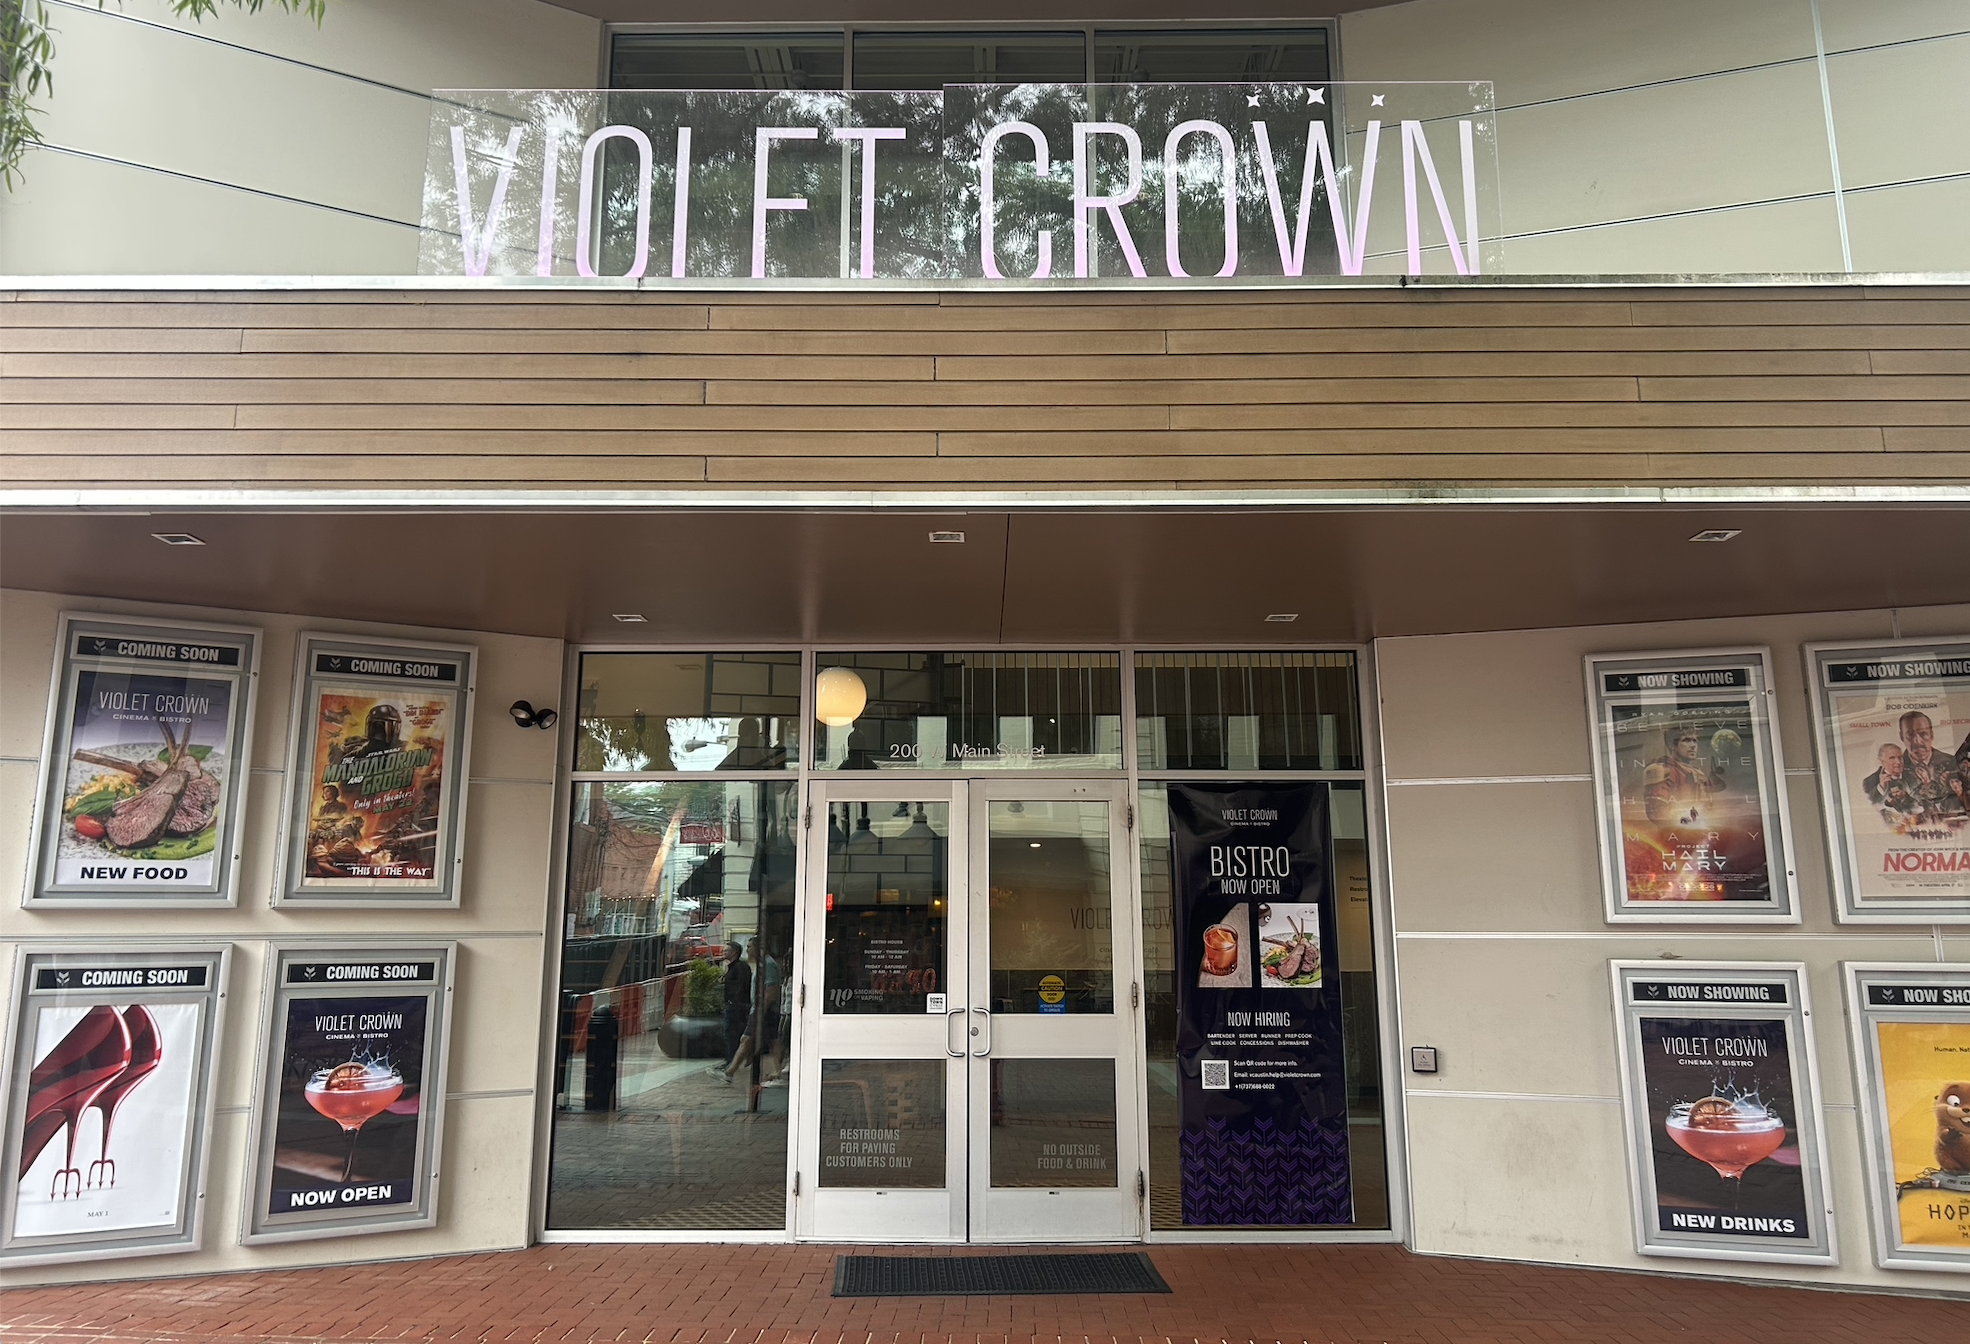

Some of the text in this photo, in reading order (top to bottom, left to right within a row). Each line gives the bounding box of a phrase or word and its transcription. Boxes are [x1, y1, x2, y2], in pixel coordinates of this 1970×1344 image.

[450, 120, 1479, 278] VIOLET CROWN
[118, 642, 219, 661] COMING SOON
[351, 659, 438, 677] COMING SOON
[1867, 661, 1970, 678] NOW SHOWING
[1638, 672, 1734, 688] NOW SHOWING
[100, 692, 209, 714] VIOLET CROWN
[1617, 720, 1747, 732] BELIEVE
[889, 743, 1045, 758] 200 W Main Street
[322, 748, 433, 783] MANDALORIAN
[342, 757, 355, 765] THE
[1621, 757, 1751, 768] IN THE
[361, 767, 415, 796] GROGU
[373, 799, 413, 814] MAY 22
[1222, 808, 1278, 820] VIOLET CROWN
[1627, 831, 1758, 841] MARY
[1211, 846, 1289, 877] BISTRO
[1662, 850, 1726, 859] HAIL
[1884, 852, 1970, 872] NORMA
[374, 867, 380, 875] IS
[385, 867, 402, 875] THE
[1663, 861, 1726, 870] MARY
[81, 867, 187, 880] NEW FOOD
[1221, 879, 1280, 895] NOW OPEN
[1070, 907, 1111, 929] VIOLE
[82, 970, 187, 985] COMING SOON
[326, 965, 418, 979] COMING SOON
[1668, 986, 1769, 1000] NOW SHOWING
[1903, 989, 1970, 1003] NOW SHO
[315, 1012, 402, 1031] VIOLET CROWN
[1228, 1012, 1290, 1026] NOW HIRING
[1662, 1036, 1767, 1056] VIOLET CROWN
[840, 1129, 900, 1140] RESTROOMS
[840, 1142, 896, 1154] FOR PAYING
[1043, 1144, 1101, 1155] NO OUTSIDE
[826, 1156, 913, 1168] CUSTOMERS ONLY
[1038, 1158, 1107, 1169] FOOD & DRINK
[290, 1185, 391, 1206] NOW OPEN
[1928, 1204, 1969, 1220] HOP
[1672, 1214, 1795, 1232] NEW DRINKS
